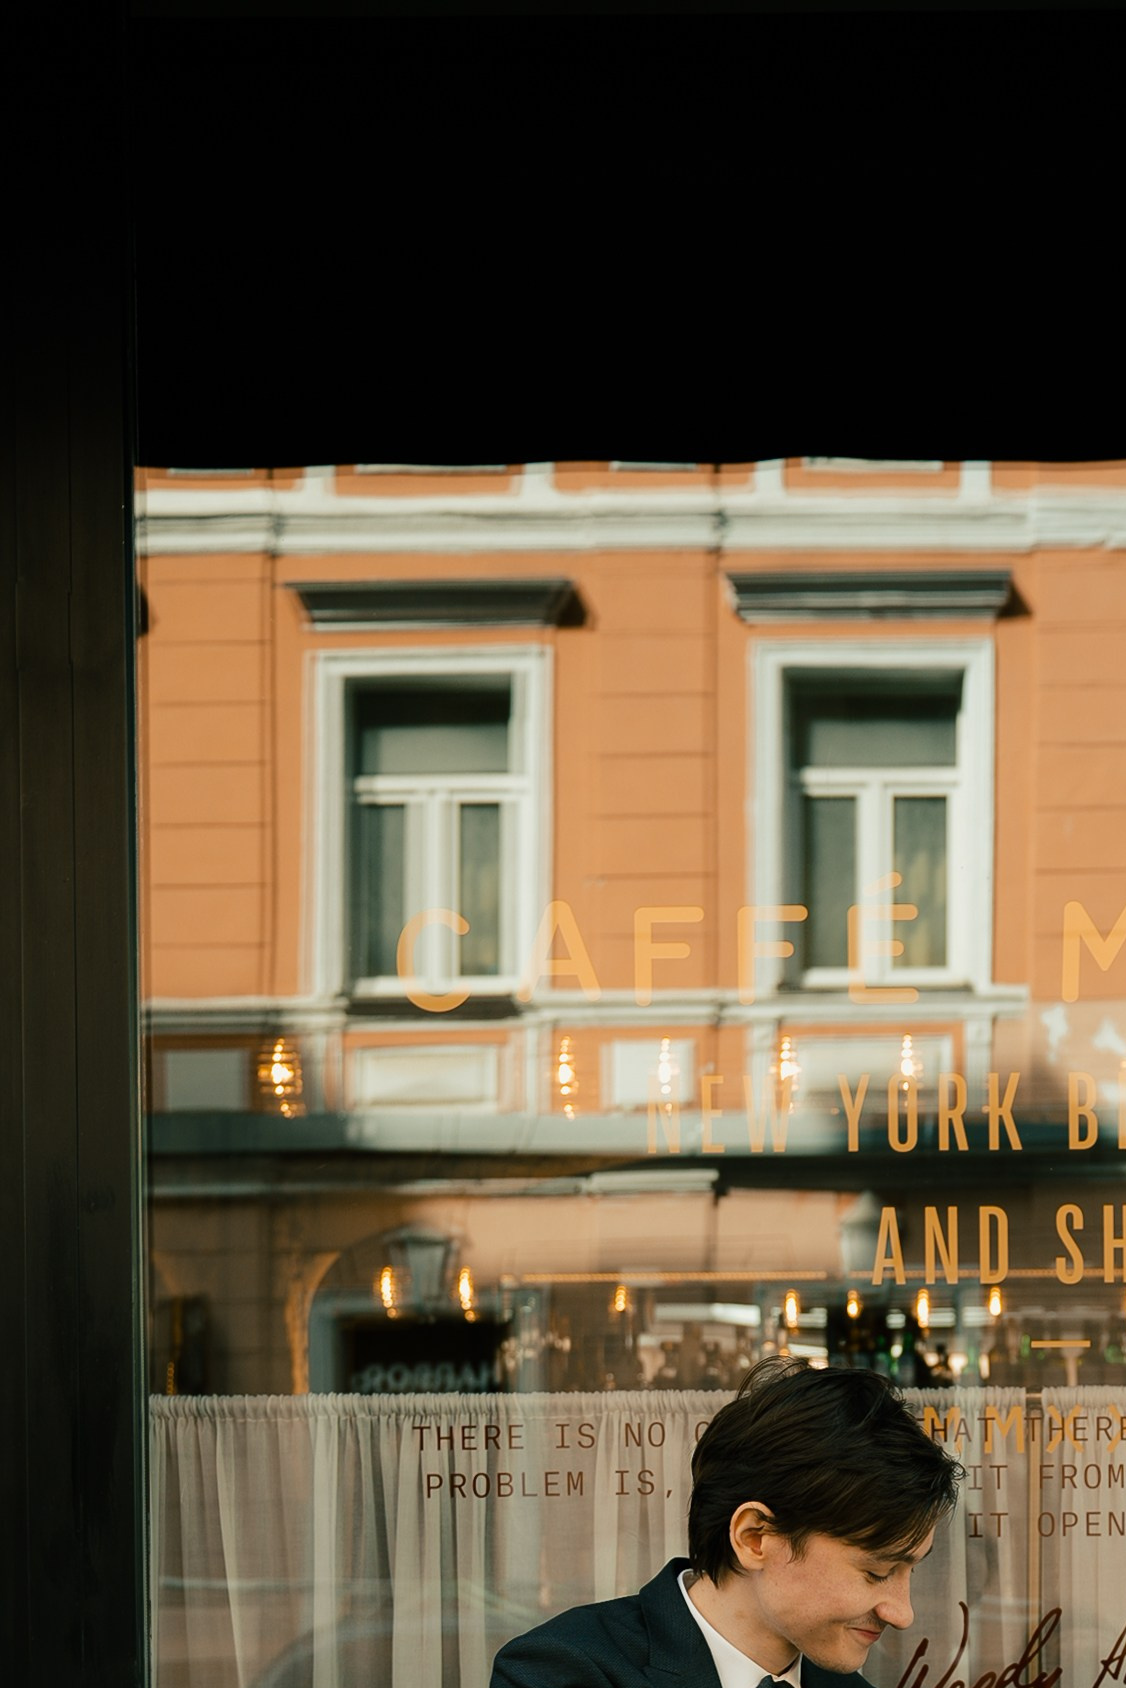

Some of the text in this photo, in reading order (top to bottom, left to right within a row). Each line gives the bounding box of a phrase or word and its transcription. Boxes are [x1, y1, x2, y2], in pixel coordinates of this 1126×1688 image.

[396, 871, 920, 1013] CAFFÉ
[647, 1073, 793, 1154] NEW
[837, 1071, 1023, 1153] YORK
[871, 1205, 1010, 1286] AND
[412, 1423, 525, 1451] THERE
[554, 1422, 596, 1449] IS
[624, 1421, 667, 1448] NO
[915, 1416, 996, 1442] HAT
[426, 1471, 585, 1499] PROBLEM
[614, 1469, 673, 1499] IS,
[967, 1464, 1009, 1490] IT
[1038, 1463, 1126, 1490] FROM
[967, 1513, 1009, 1539] IT
